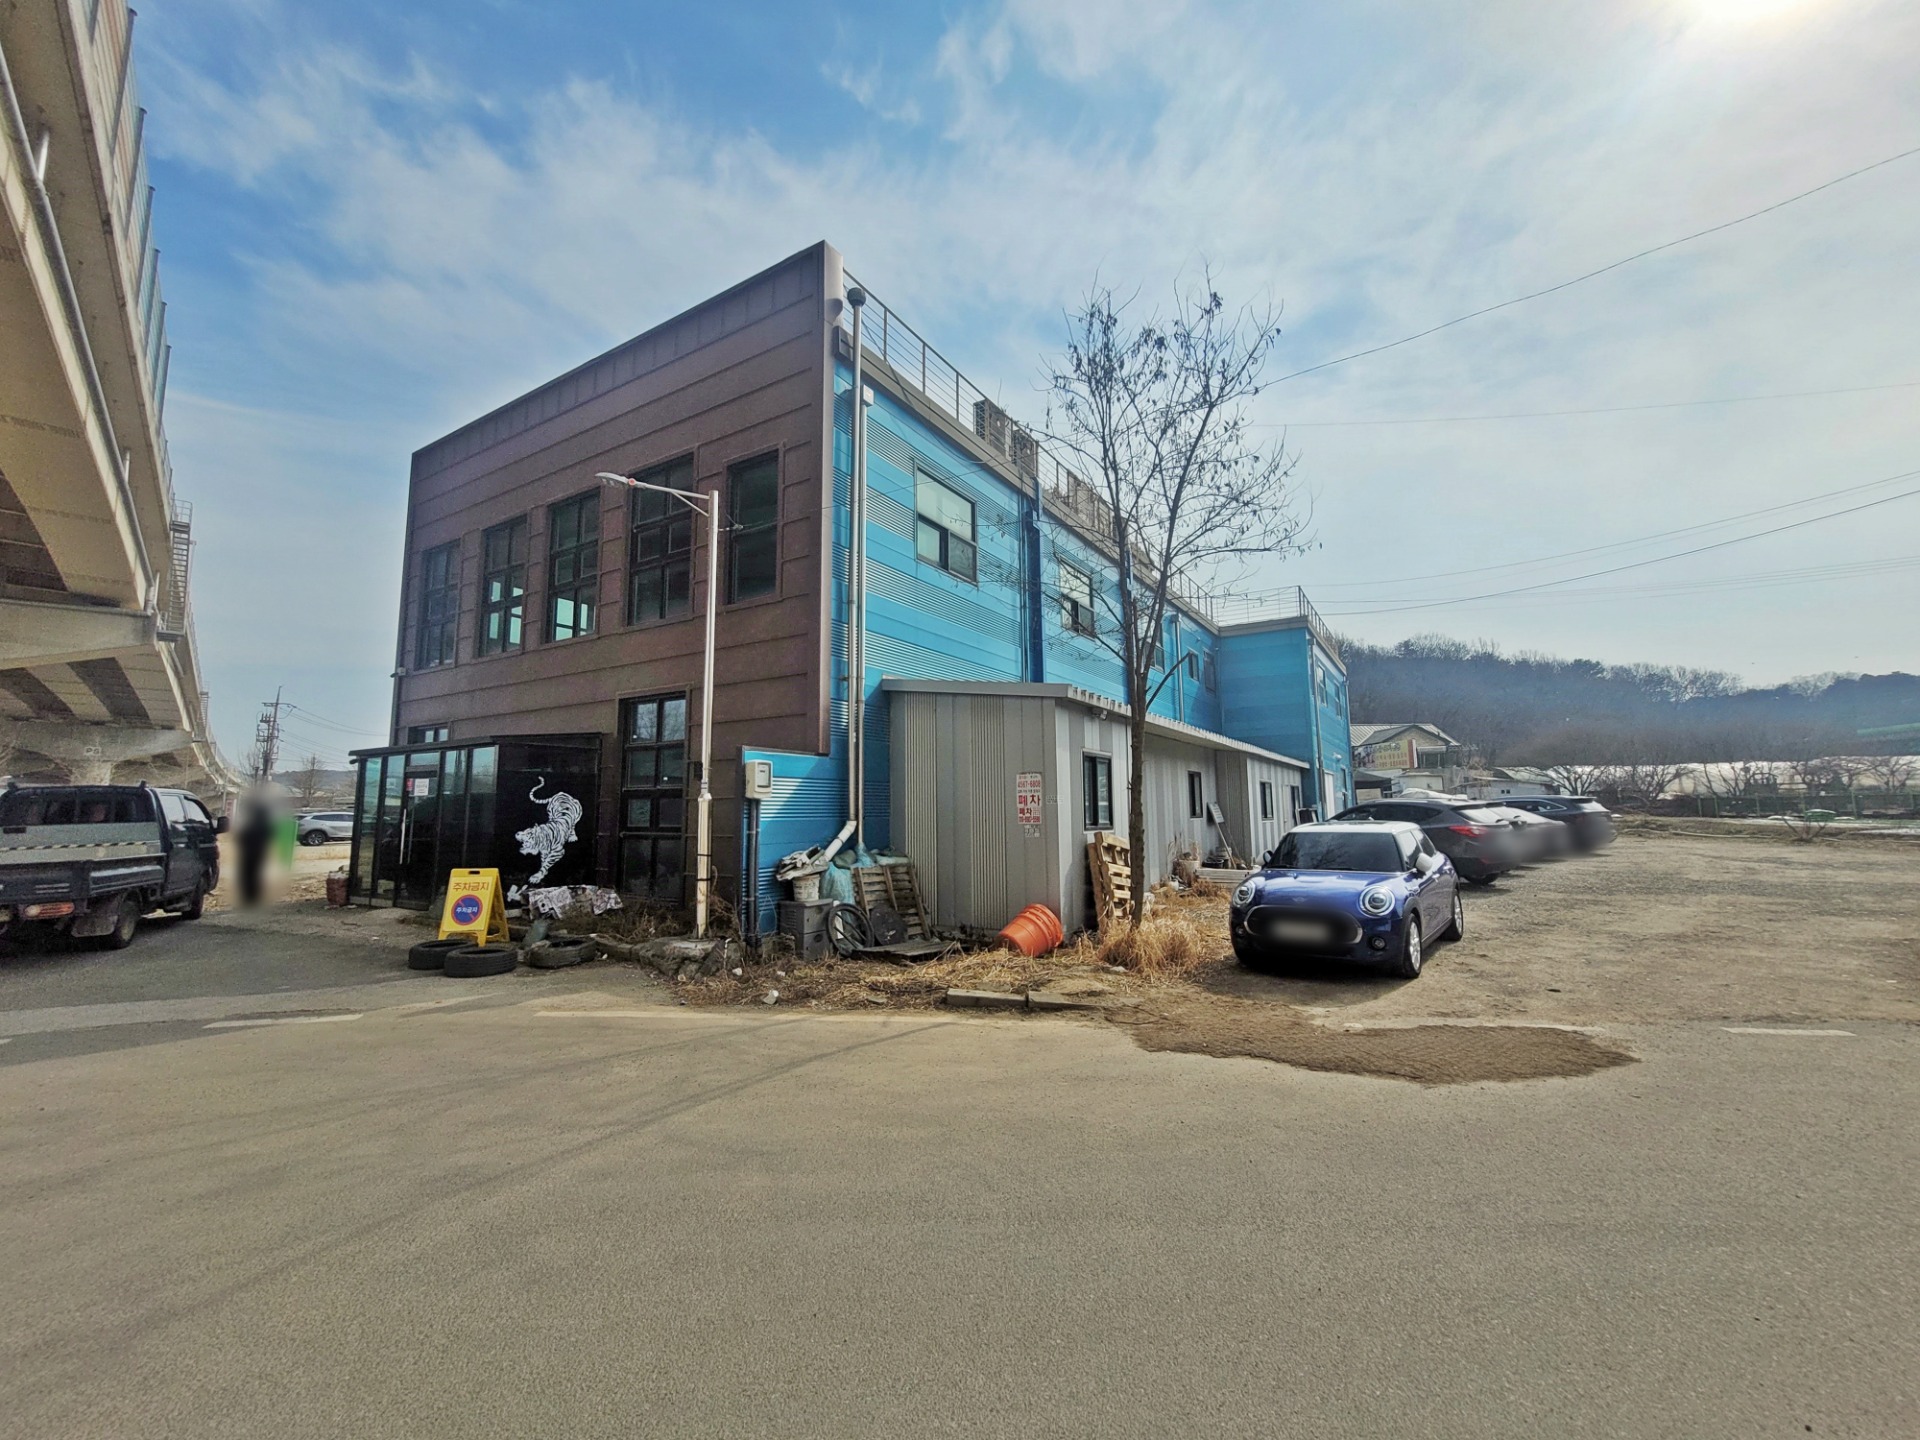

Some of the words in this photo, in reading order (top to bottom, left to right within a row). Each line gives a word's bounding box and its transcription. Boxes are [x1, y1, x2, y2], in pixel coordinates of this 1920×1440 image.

[1018, 794, 1041, 806] 폐차
[453, 881, 489, 892] 주차금지
[456, 906, 478, 914] 주차금지
